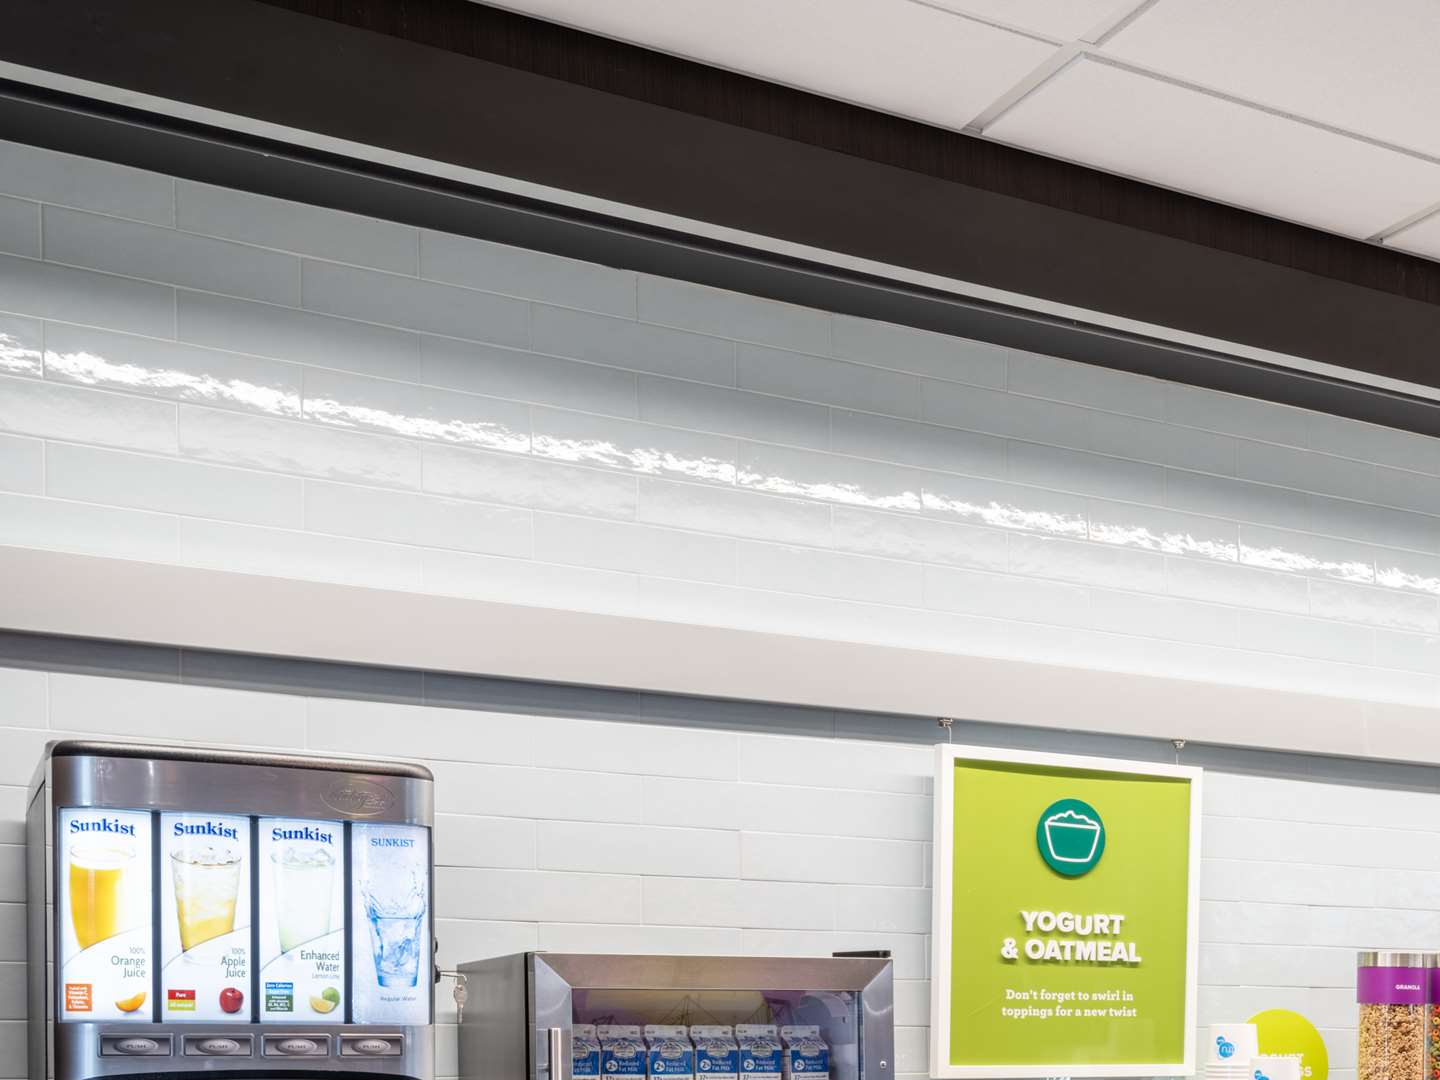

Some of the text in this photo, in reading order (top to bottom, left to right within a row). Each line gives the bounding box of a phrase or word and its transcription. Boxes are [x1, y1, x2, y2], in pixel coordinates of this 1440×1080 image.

[70, 818, 136, 837] Sunkist
[174, 822, 239, 841] Sunkist
[272, 827, 333, 845] Sunkist
[371, 838, 416, 848] SUNKIST
[1020, 911, 1125, 936] YOGURT
[300, 950, 340, 960] Enhanced
[1000, 937, 1142, 962] & OATMEAL
[111, 955, 146, 968] Orange
[220, 956, 246, 969] Apple
[316, 961, 340, 972] Water
[123, 967, 146, 978] Juice
[225, 967, 246, 978] Juice
[1006, 989, 1133, 1003] Don't forget to swirl in
[1002, 1005, 1136, 1019] toppings for a new twist
